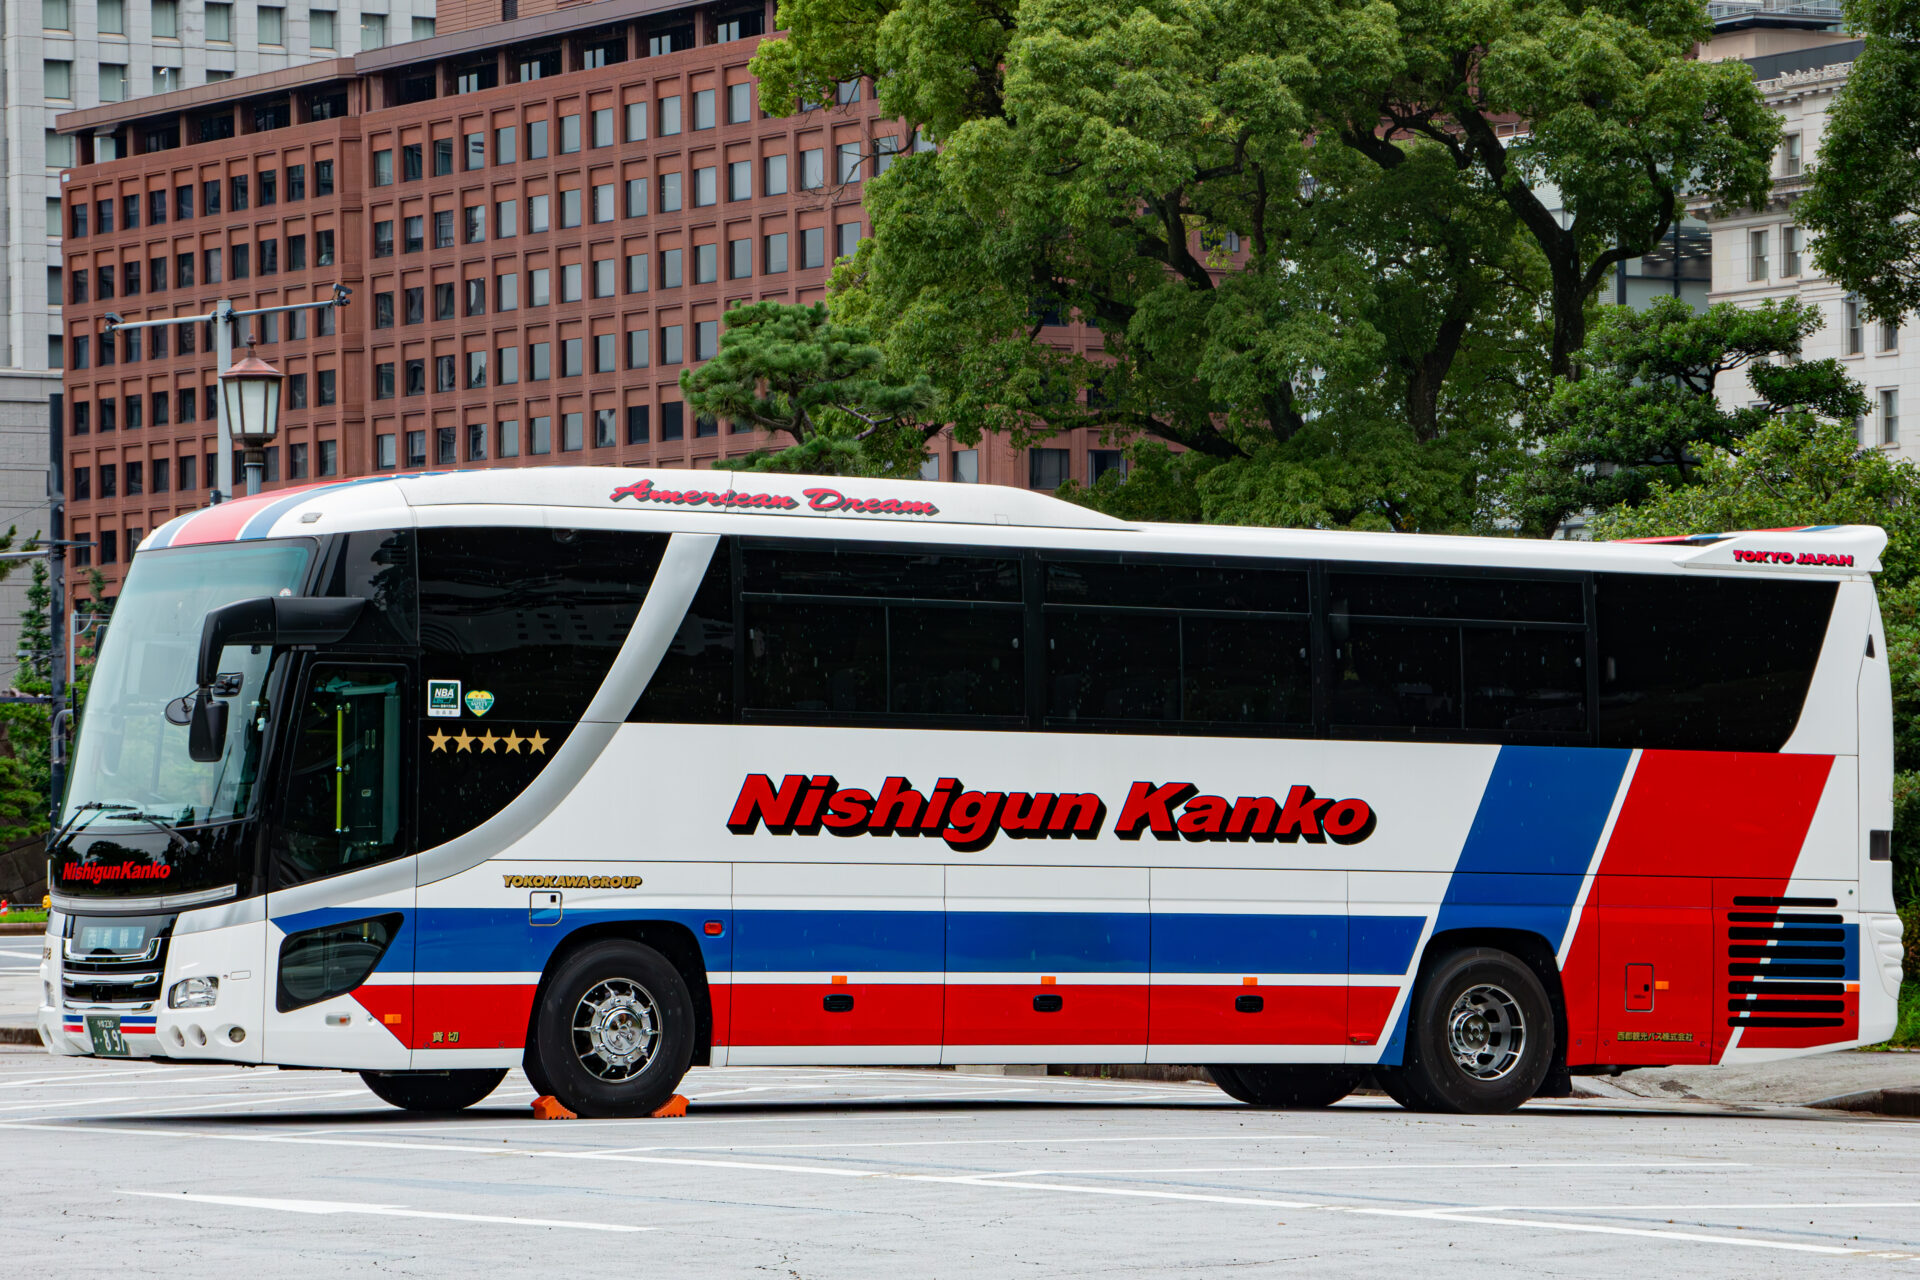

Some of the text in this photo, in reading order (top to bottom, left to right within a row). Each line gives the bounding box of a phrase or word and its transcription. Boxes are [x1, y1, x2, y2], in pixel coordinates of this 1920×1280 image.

[609, 478, 940, 516] American Dream
[1733, 549, 1854, 567] TOKYO JAPAN
[434, 688, 454, 698] NBA
[727, 773, 1377, 852] Nishigun Kanko
[503, 875, 642, 889] YOKOKAWAGROUP
[432, 1031, 460, 1043] 貸切
